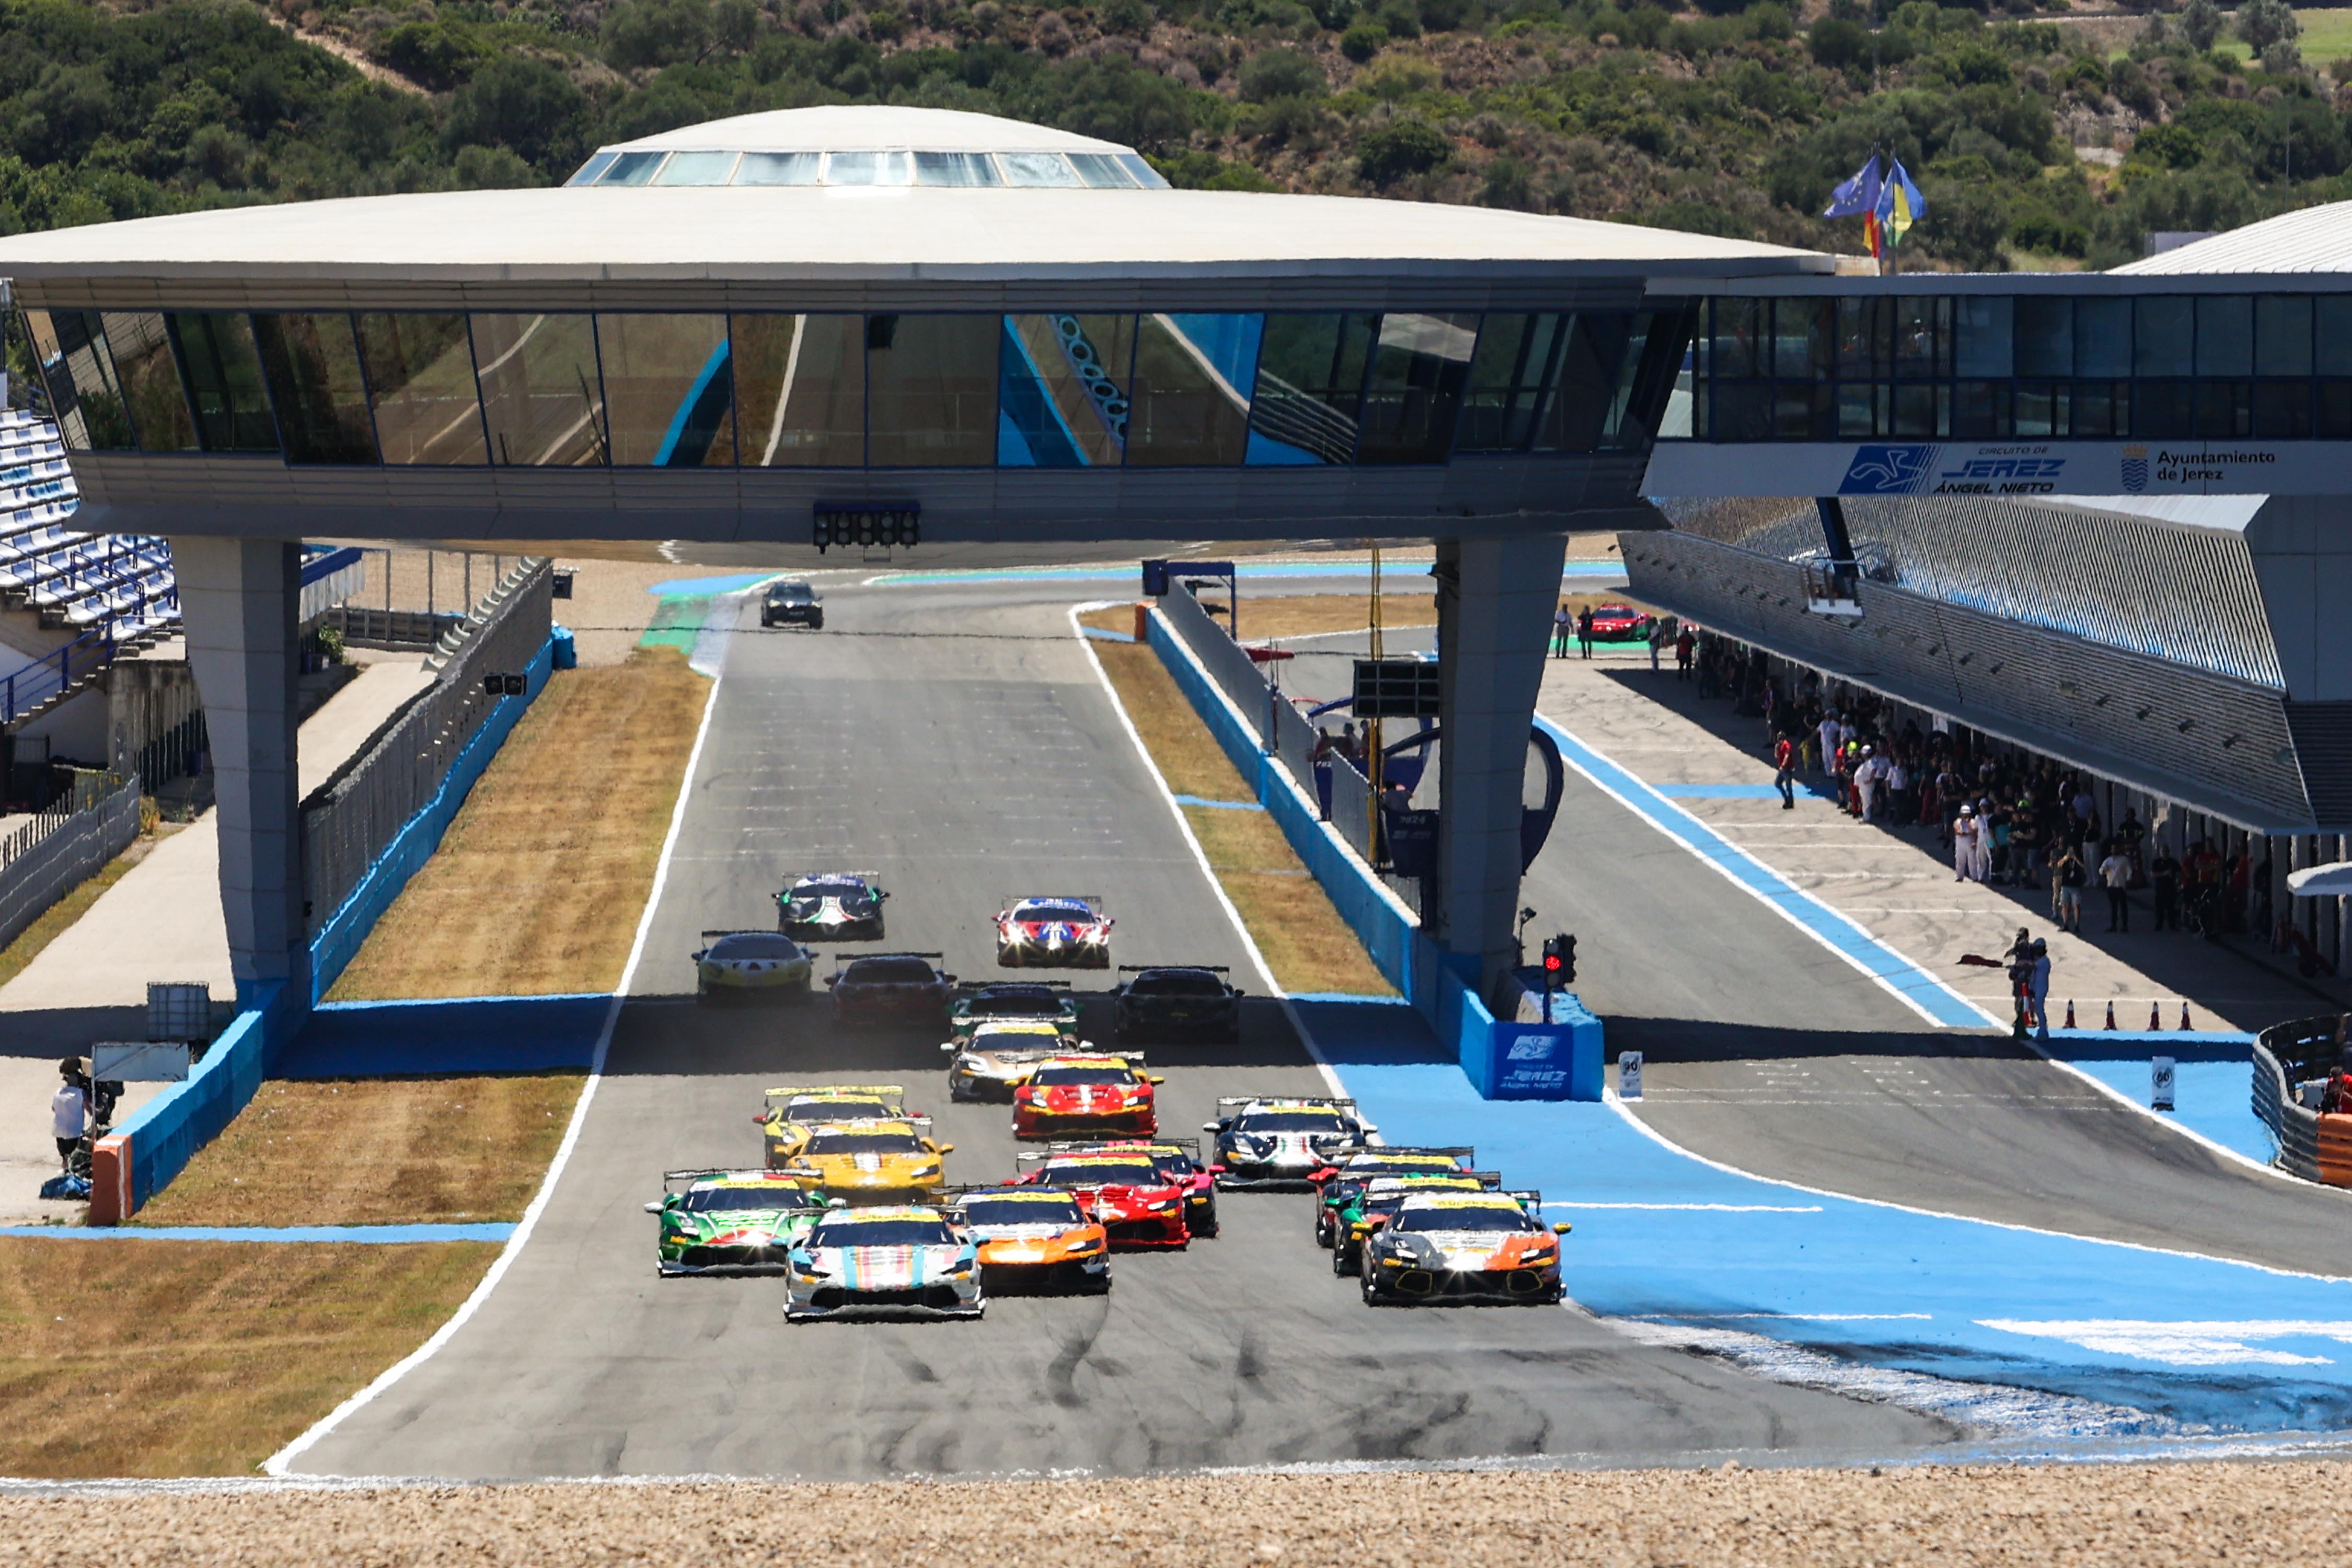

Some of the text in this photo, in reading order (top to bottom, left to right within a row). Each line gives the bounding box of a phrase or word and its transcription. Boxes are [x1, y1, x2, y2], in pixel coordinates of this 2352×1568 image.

[2157, 450, 2275, 467] Ayuntamiento
[1942, 459, 2067, 477] JEREZ
[2157, 467, 2223, 483] de Jerez
[1933, 480, 2054, 493] ÁNGEL NIETO
